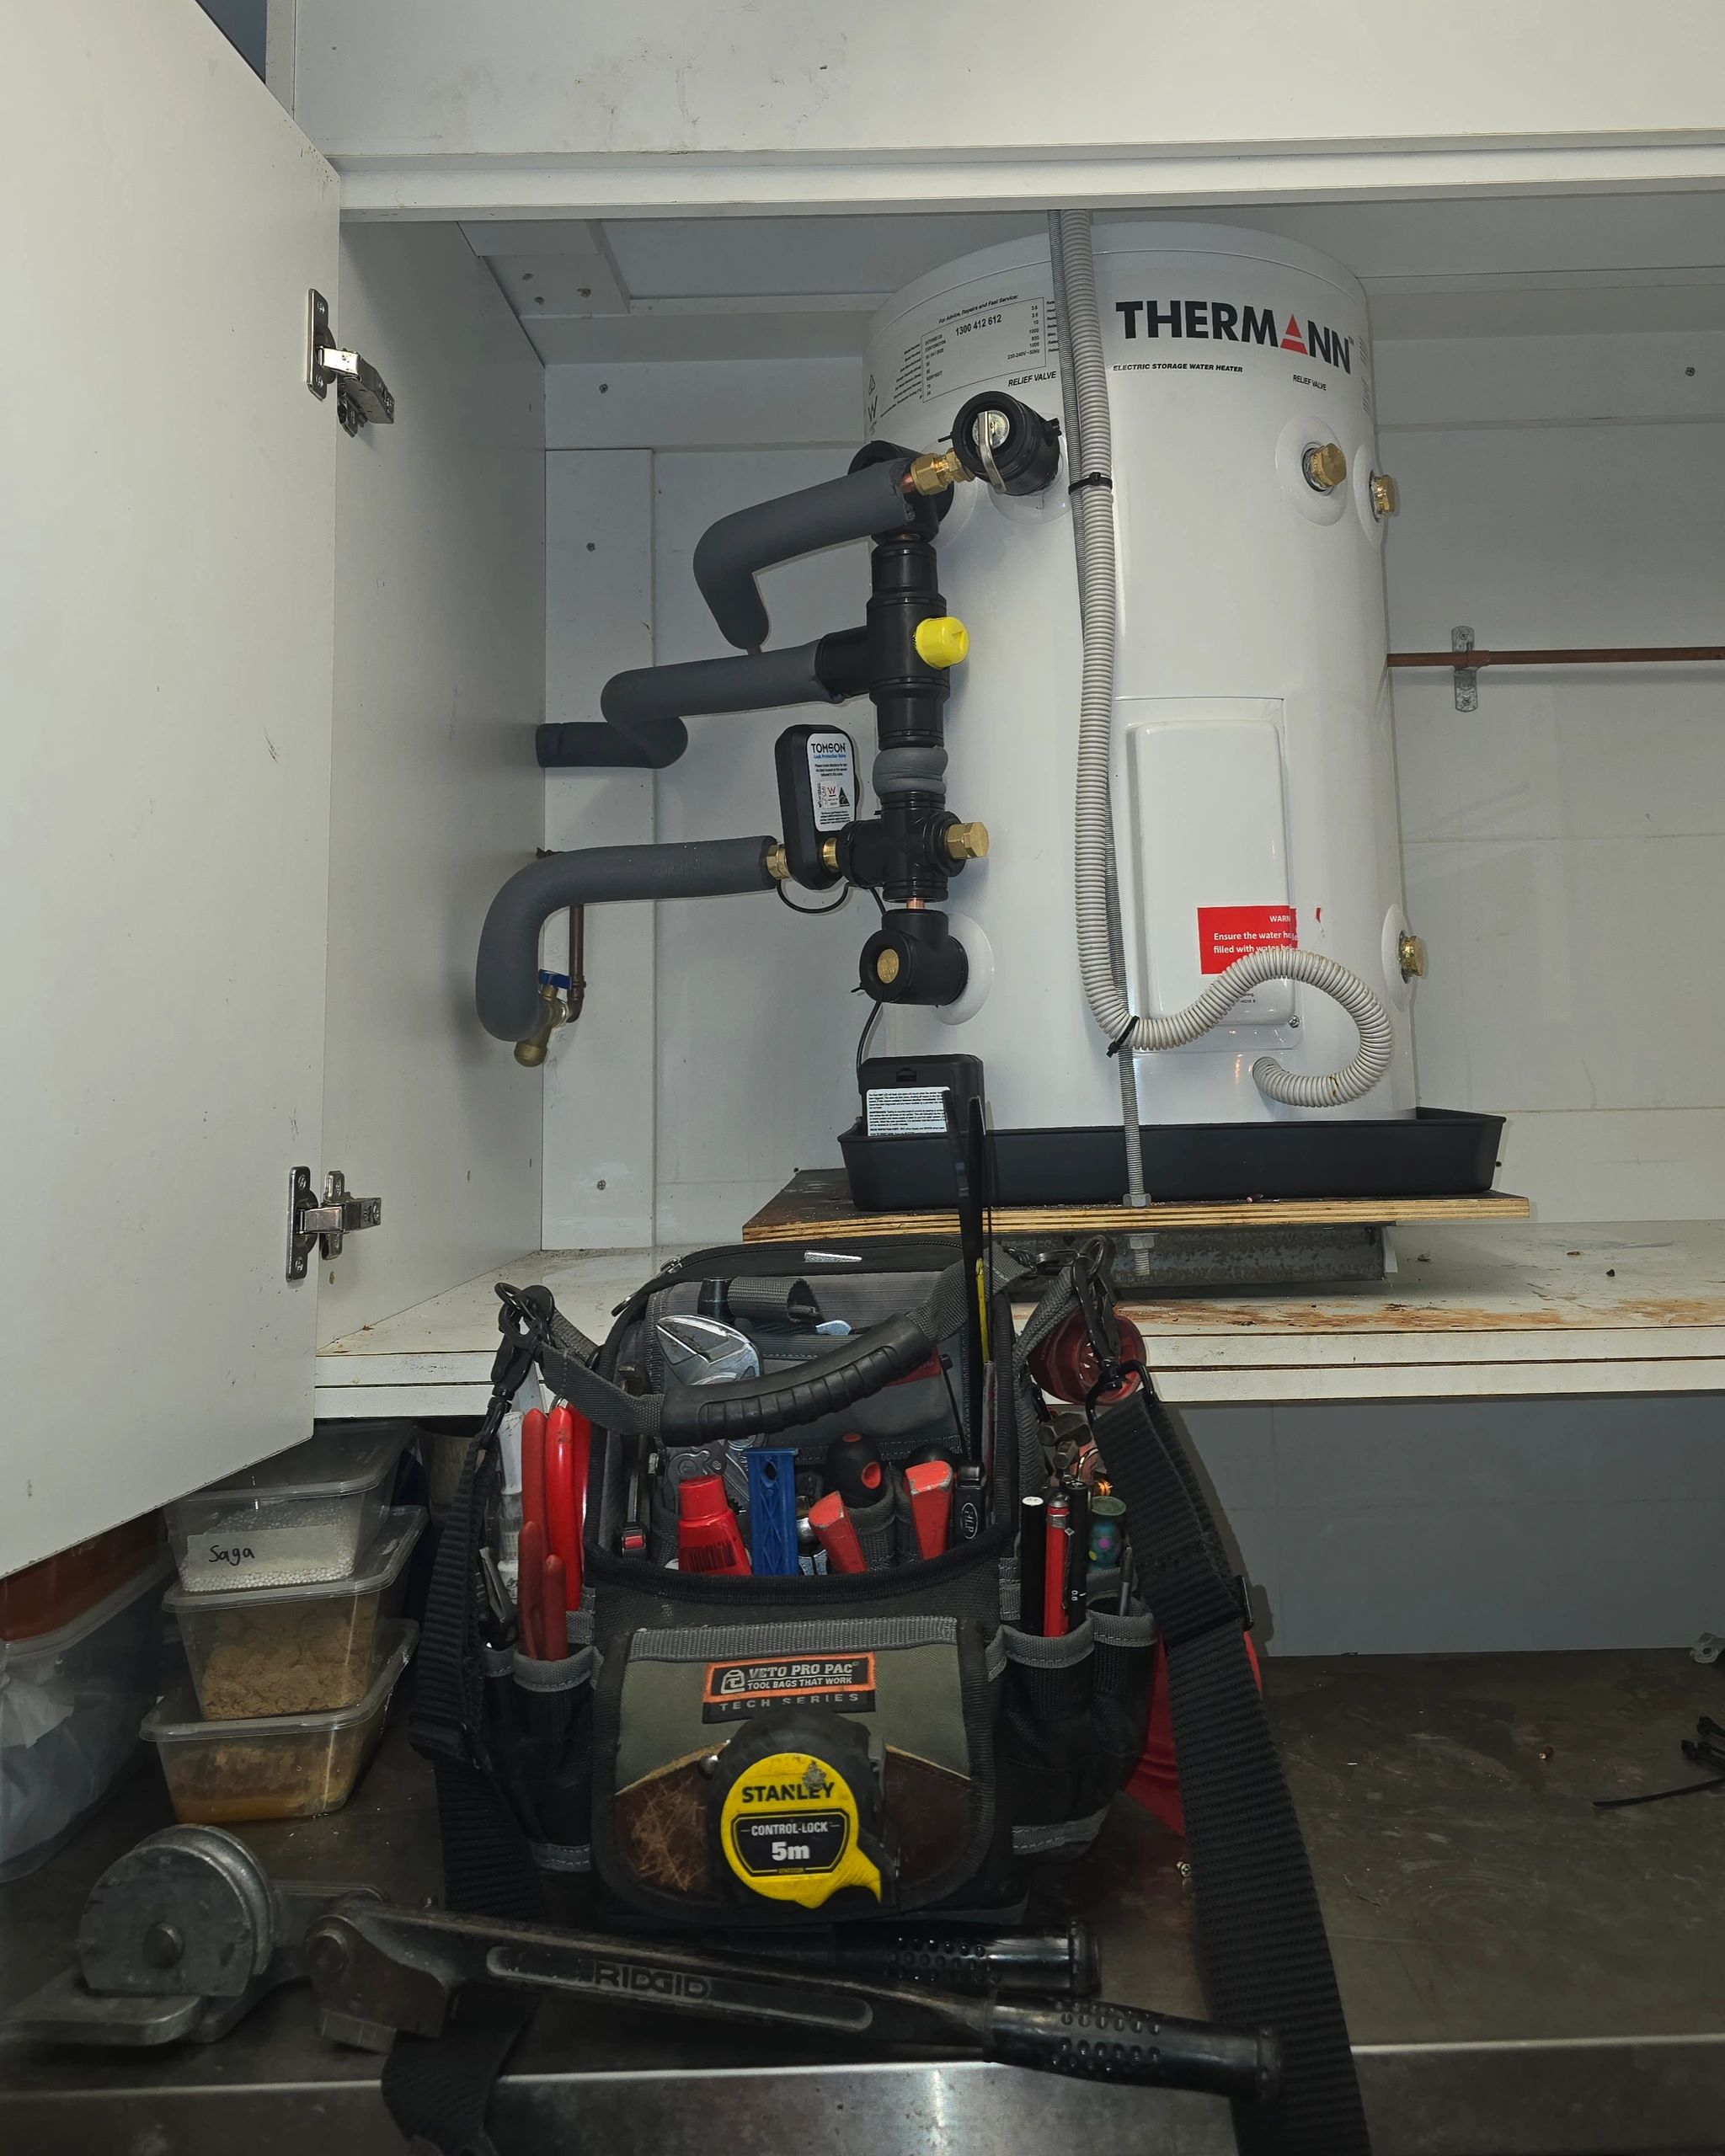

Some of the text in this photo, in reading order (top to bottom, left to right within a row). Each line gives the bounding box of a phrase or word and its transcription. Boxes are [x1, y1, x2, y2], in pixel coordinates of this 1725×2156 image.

[955, 313, 1002, 336] 1300 412 612
[1115, 300, 1351, 375] THERMANN
[1113, 363, 1151, 371] ELECTRIC
[1215, 364, 1243, 373] HEATER
[1007, 371, 1057, 387] RELIEF VALVE
[1293, 374, 1327, 391] RELIEF VALVE
[811, 743, 846, 754] TOMSON
[1214, 932, 1242, 941] Ensure
[1242, 931, 1257, 940] the
[1214, 945, 1235, 953] filled
[209, 1545, 255, 1566] Saga
[748, 1662, 853, 1679] VETO PRO PAC
[747, 1680, 771, 1690] TOOL
[772, 1679, 798, 1689] BAGS
[799, 1678, 824, 1687] THAT
[719, 1693, 859, 1711] TECH SERIES
[742, 1782, 836, 1803] STANLEY
[751, 1821, 829, 1836] CONTROL-LOCK
[772, 1841, 810, 1861] 5m
[594, 1961, 710, 1999] RIDGID
